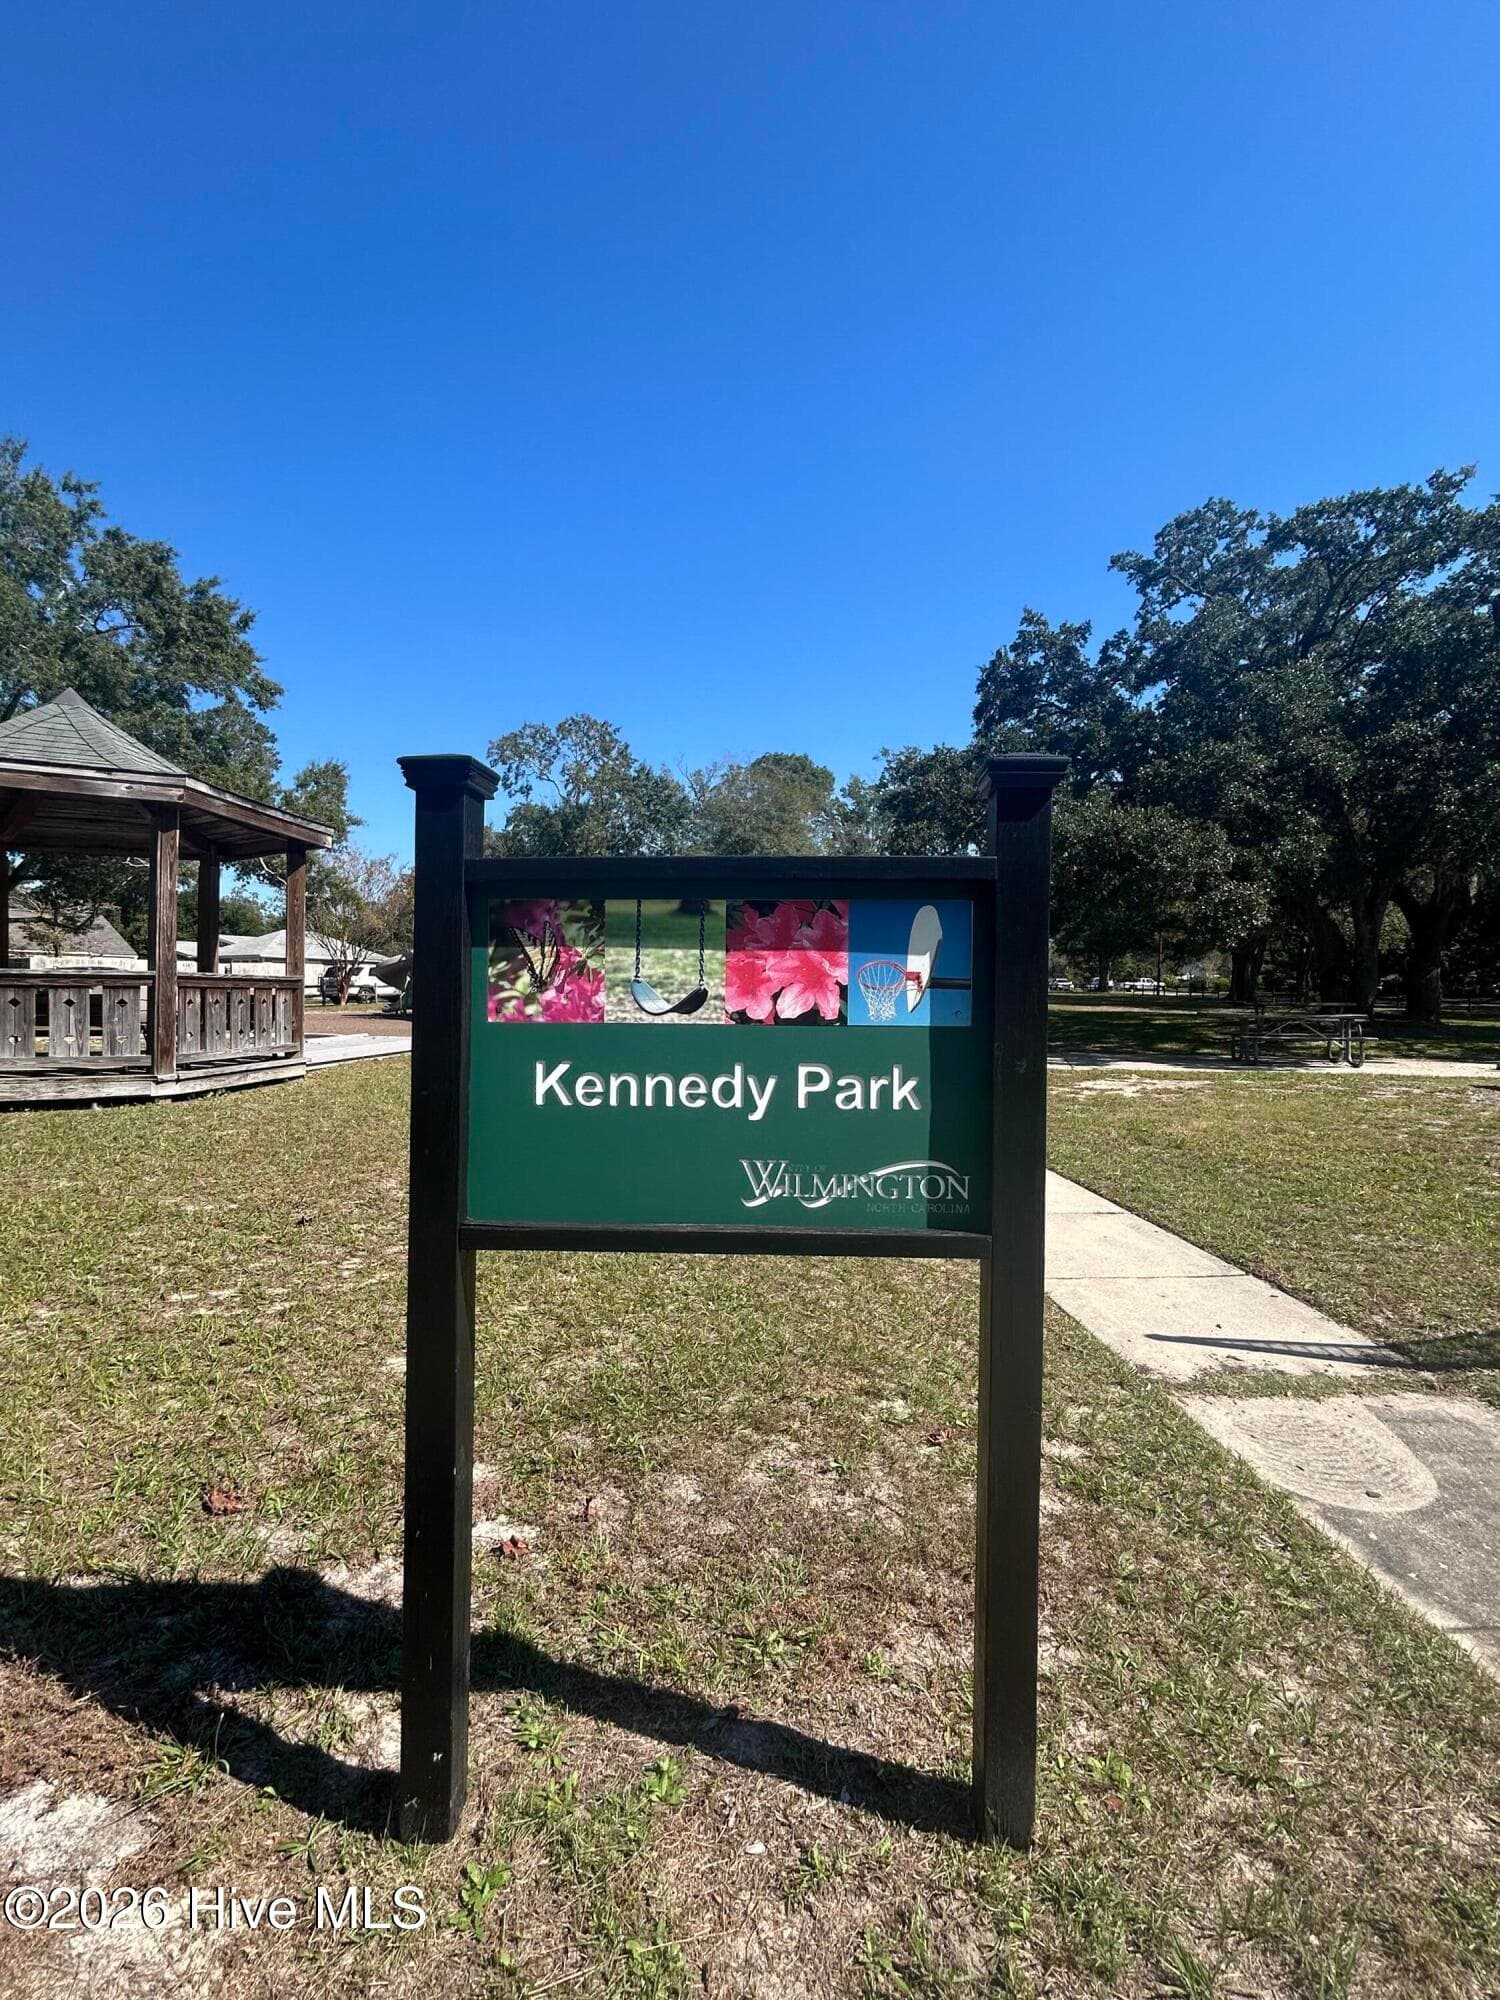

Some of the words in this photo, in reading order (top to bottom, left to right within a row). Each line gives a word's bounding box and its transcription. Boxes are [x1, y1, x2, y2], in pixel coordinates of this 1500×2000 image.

[534, 1061, 778, 1121] Kennedy
[797, 1063, 922, 1111] Park
[739, 1159, 971, 1200] WILMINGTON
[866, 1202, 906, 1214] NORTH
[910, 1203, 971, 1214] CAROLINA
